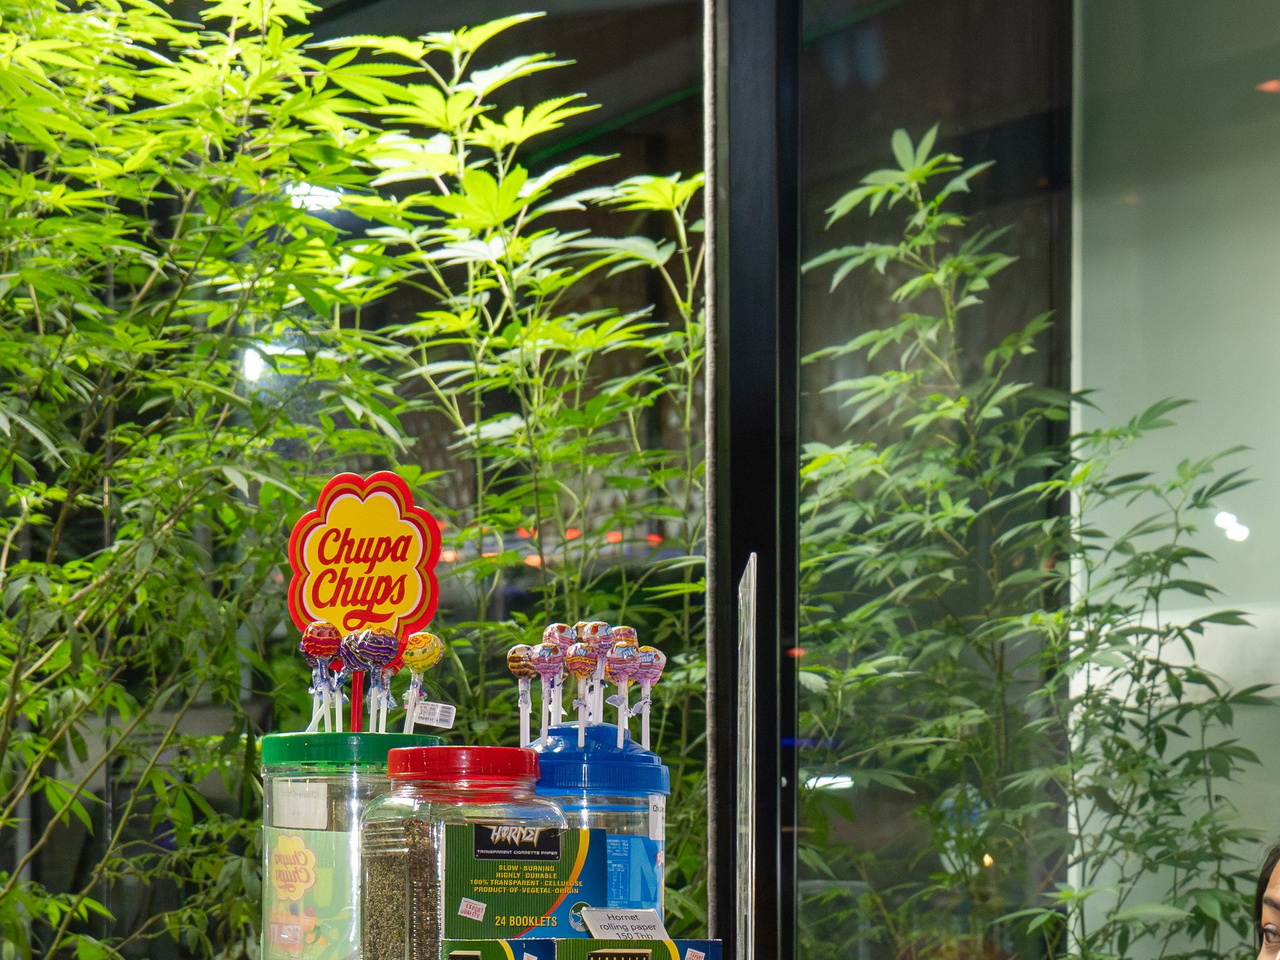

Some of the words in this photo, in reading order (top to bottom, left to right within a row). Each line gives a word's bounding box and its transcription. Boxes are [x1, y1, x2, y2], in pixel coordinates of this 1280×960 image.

[318, 528, 413, 574] Chupa
[312, 567, 408, 631] Chups
[490, 879, 539, 887] TRANSPARENT
[495, 916, 506, 927] 24
[509, 916, 558, 927] BOOKLETS
[606, 913, 640, 921] Hornet
[599, 923, 630, 932] rolling
[630, 924, 657, 932] paper
[616, 932, 634, 940] 150
